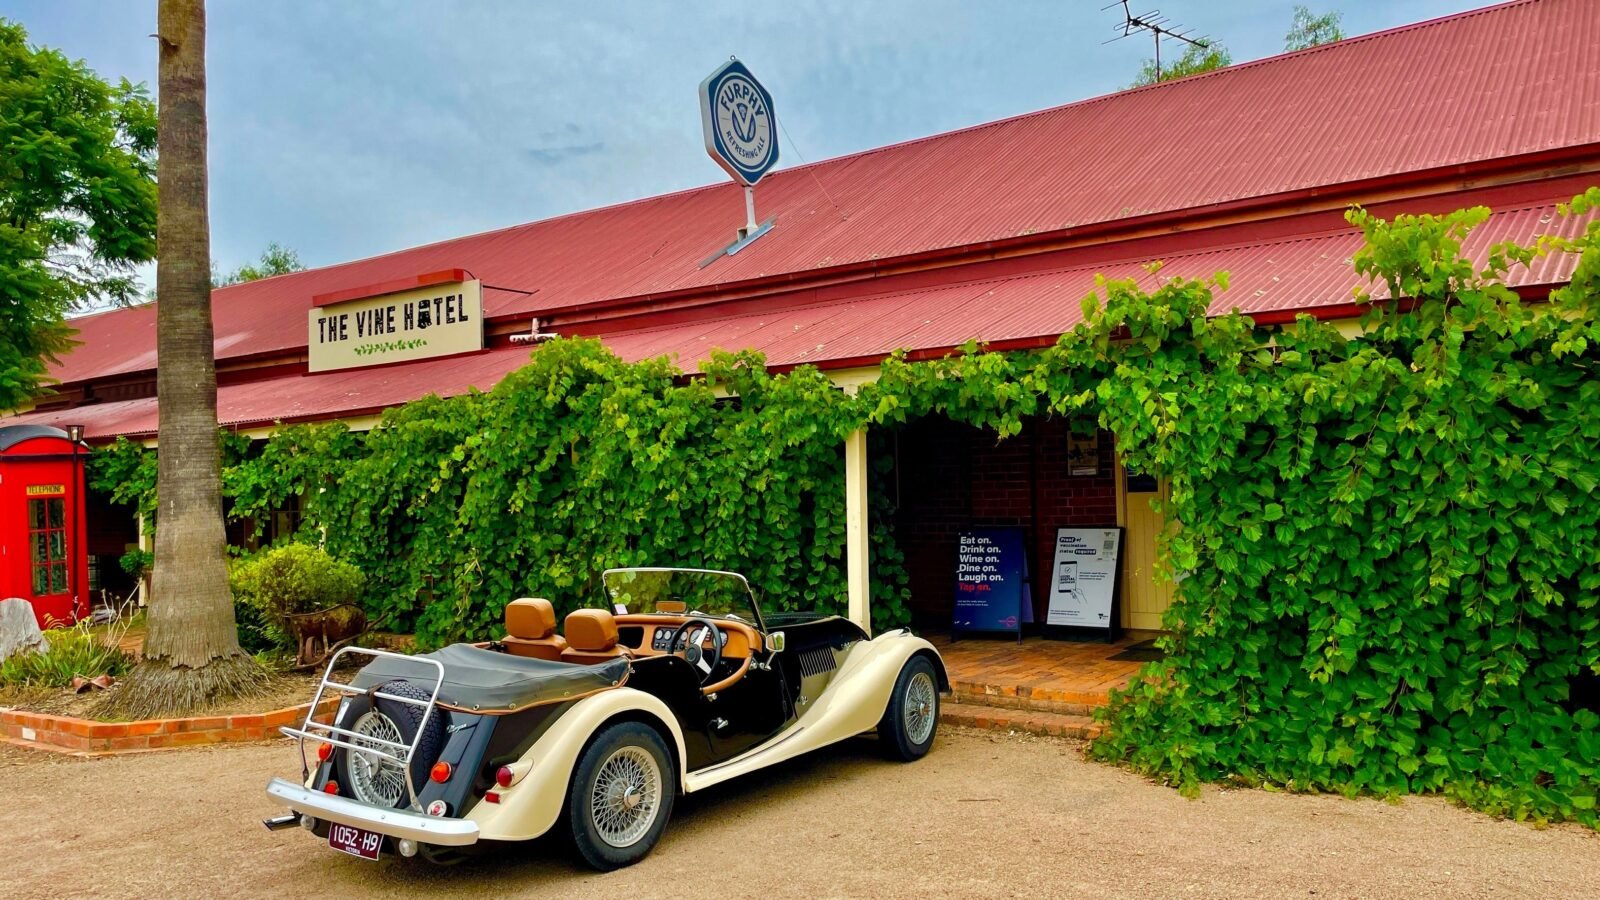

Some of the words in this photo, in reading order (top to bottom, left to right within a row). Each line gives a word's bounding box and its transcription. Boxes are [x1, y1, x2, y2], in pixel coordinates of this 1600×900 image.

[721, 83, 764, 117] FURPHY
[726, 130, 758, 158] REFRESHING
[318, 314, 348, 343] THE
[356, 306, 395, 337] VINE
[29, 485, 62, 494] TELEPHONE
[960, 536, 976, 544] Eat
[960, 545, 985, 553] Drink
[960, 555, 983, 563] Wine
[959, 564, 981, 572] Dine
[958, 573, 987, 583] Laugh
[959, 582, 975, 592] Tap
